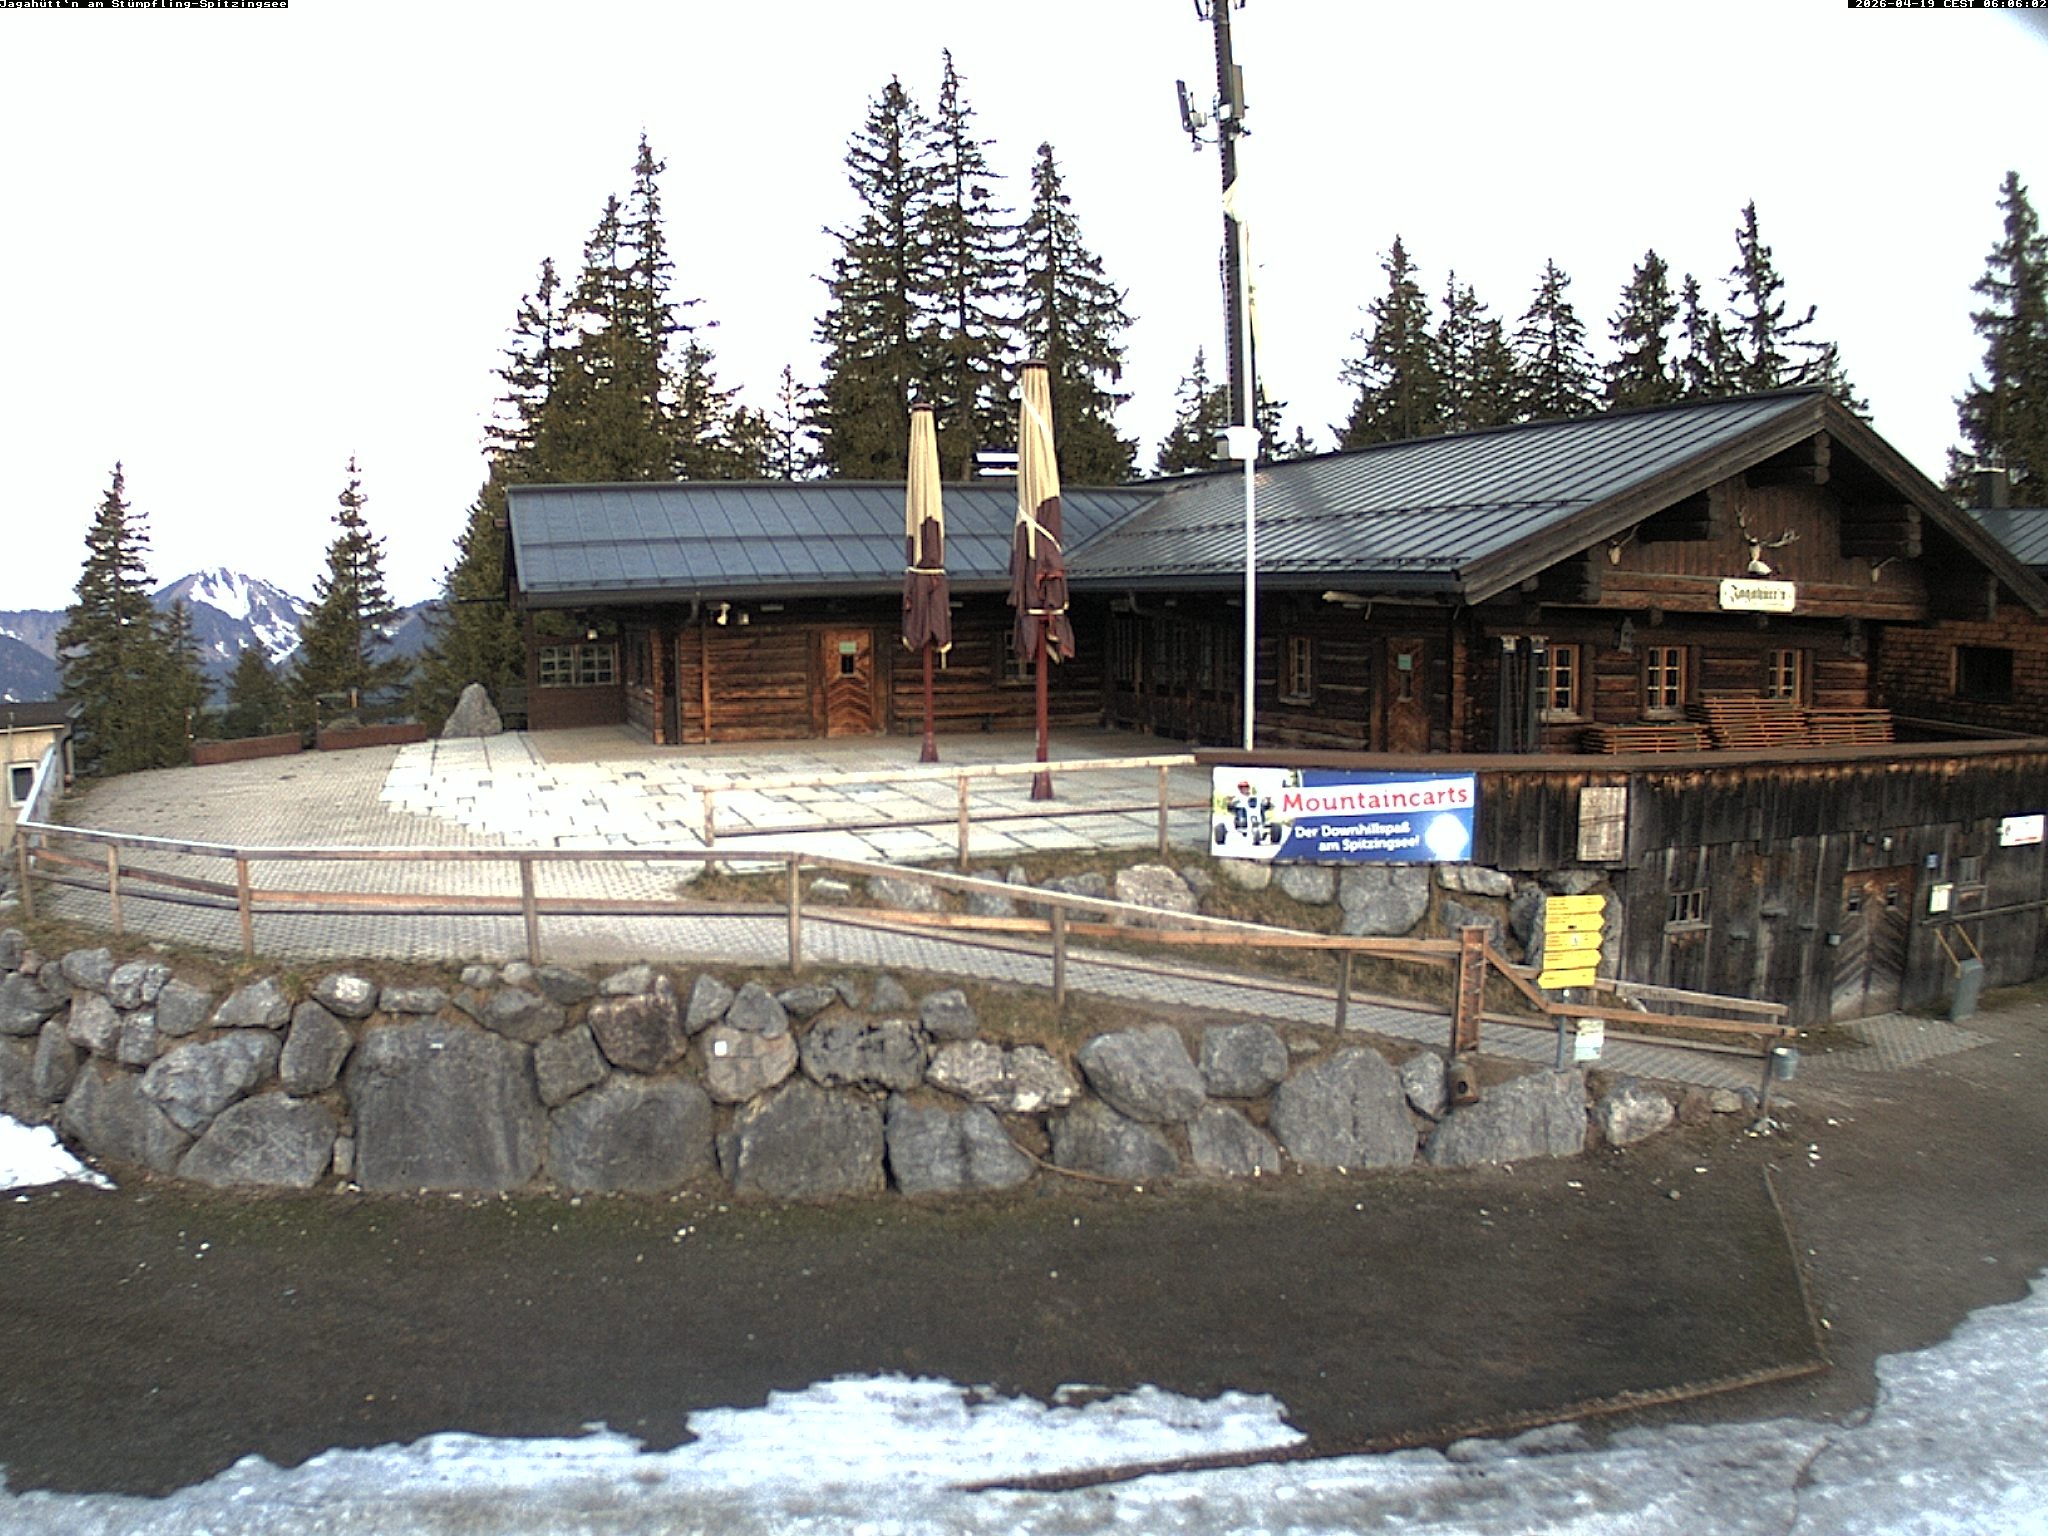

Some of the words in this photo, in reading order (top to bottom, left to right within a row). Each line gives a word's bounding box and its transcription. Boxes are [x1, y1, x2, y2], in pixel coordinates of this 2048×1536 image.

[1282, 787, 1468, 813] Mountaincarts
[1294, 826, 1319, 839] Der
[1321, 821, 1411, 837] Downhillspaß
[1318, 841, 1341, 852] am
